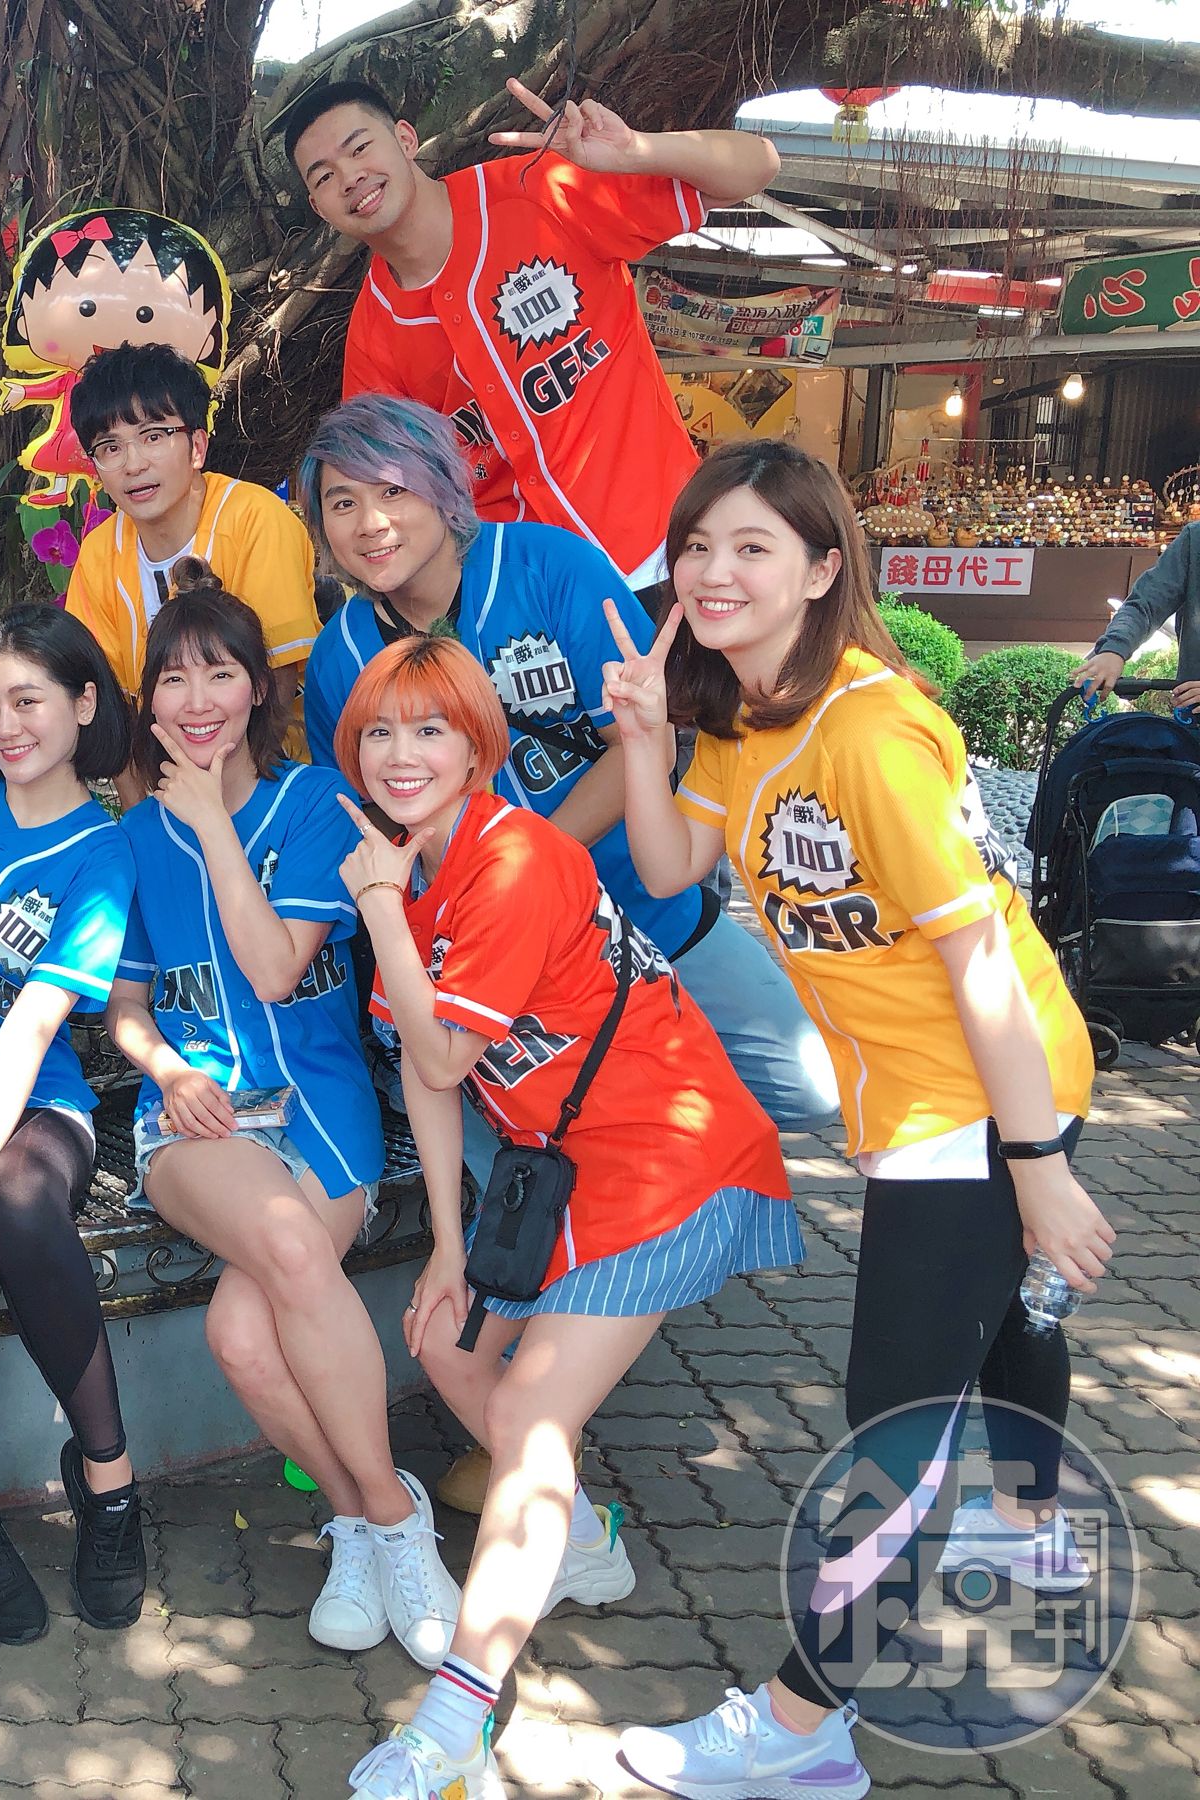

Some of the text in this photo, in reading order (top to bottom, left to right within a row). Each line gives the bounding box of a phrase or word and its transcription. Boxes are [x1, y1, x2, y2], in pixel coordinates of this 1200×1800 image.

[511, 286, 562, 329] 100
[886, 554, 1024, 587] 錢母代工
[510, 660, 572, 701] 100
[782, 830, 845, 873] 100
